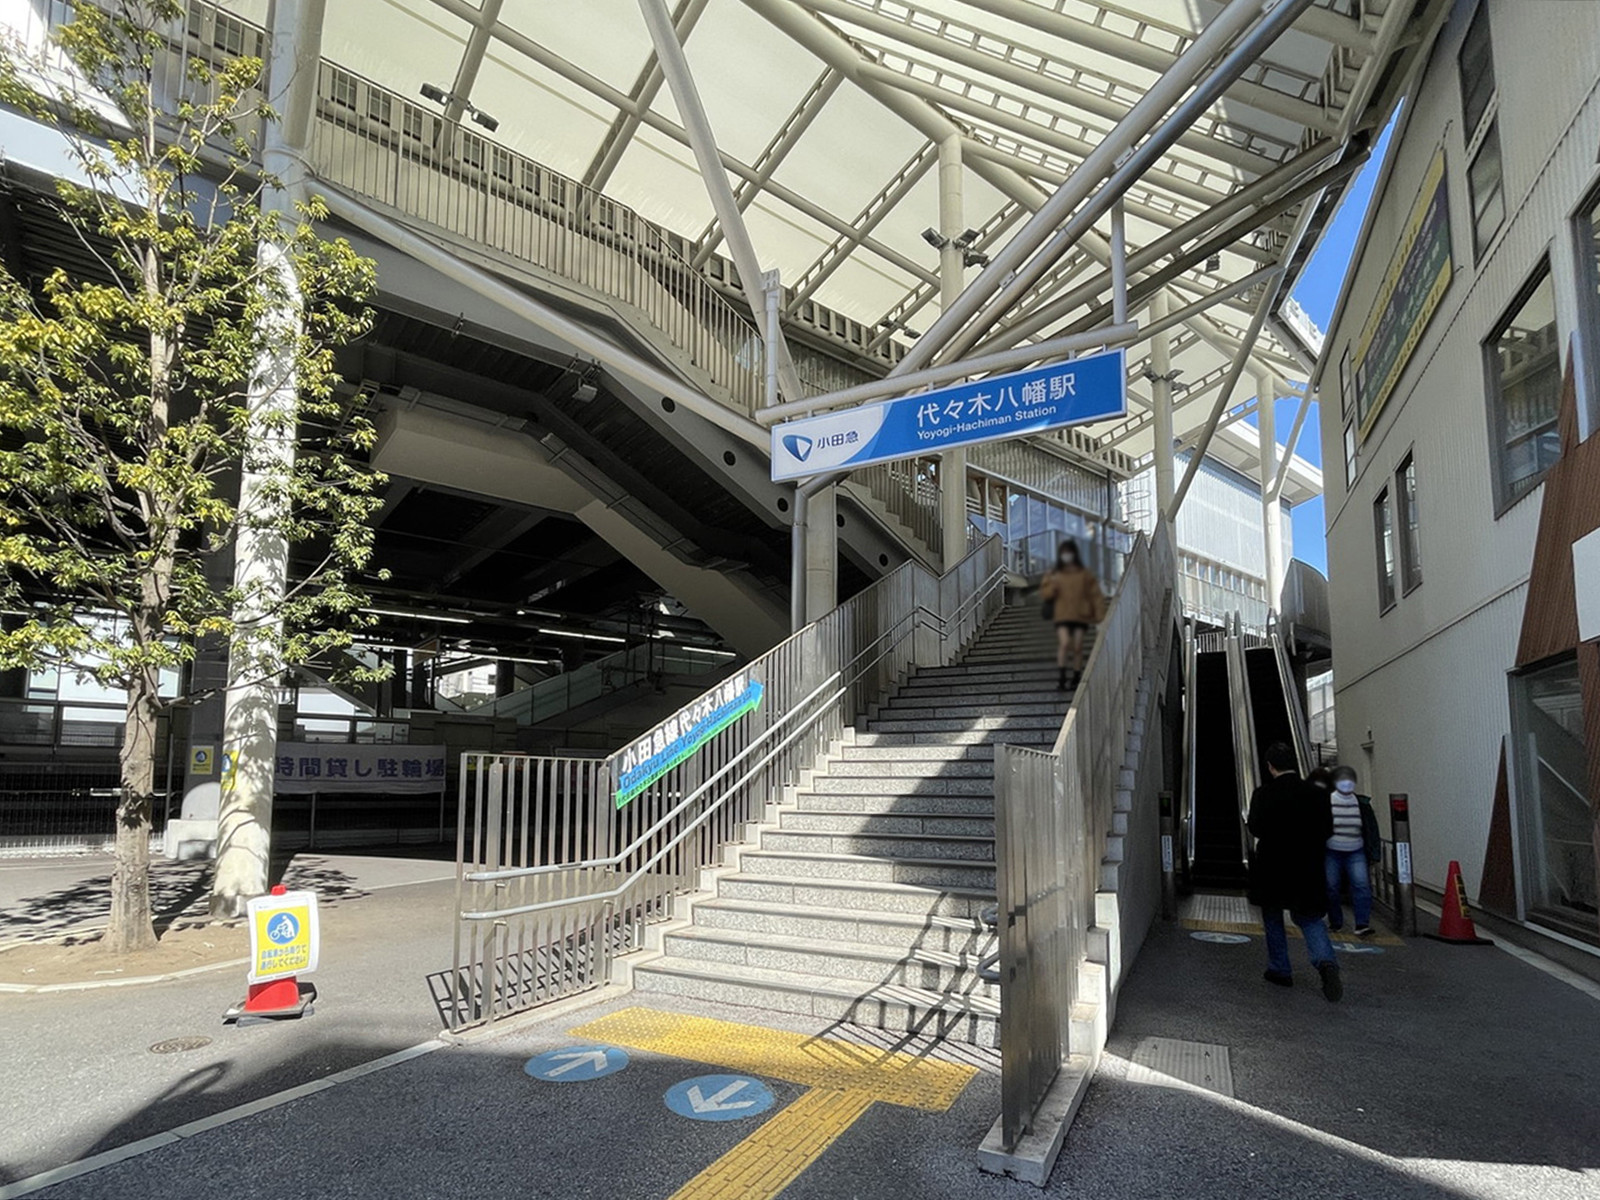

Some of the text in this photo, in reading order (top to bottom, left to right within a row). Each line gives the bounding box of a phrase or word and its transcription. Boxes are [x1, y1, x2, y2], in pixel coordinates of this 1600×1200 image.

[917, 373, 1076, 427] 代々木八幡駅
[917, 405, 1057, 440] Yoyogi-Hachiman Station
[817, 431, 859, 449] 小田急
[622, 757, 660, 789] Odakyu
